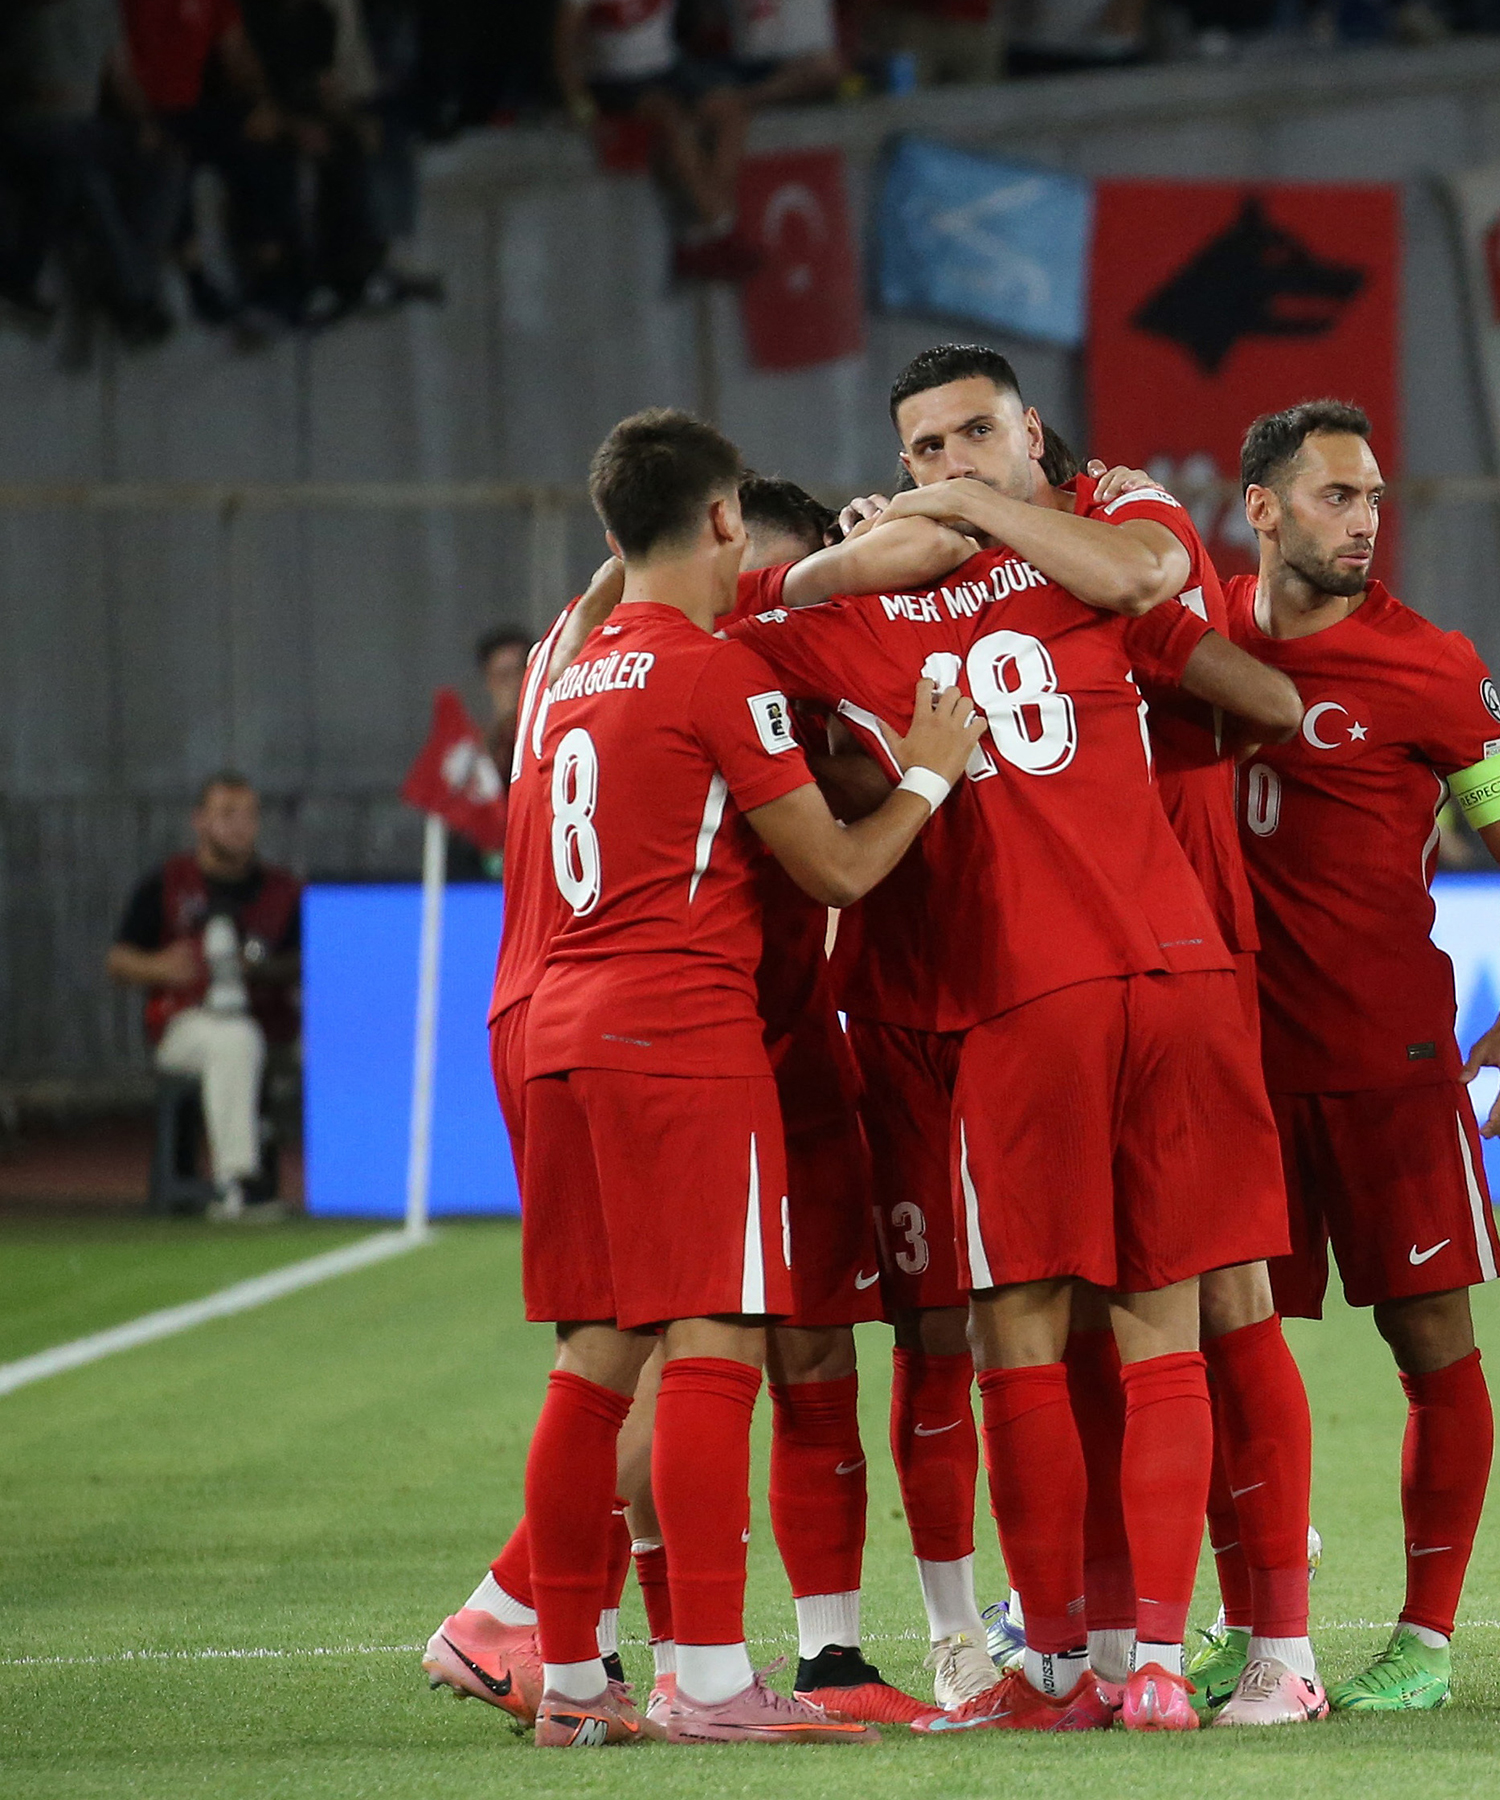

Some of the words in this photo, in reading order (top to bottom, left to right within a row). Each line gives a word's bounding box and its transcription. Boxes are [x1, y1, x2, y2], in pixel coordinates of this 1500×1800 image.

[940, 558, 1048, 619] MÜLDÜR
[585, 650, 656, 696] GÜLER
[552, 727, 600, 917] 8
[1236, 763, 1281, 837] 0
